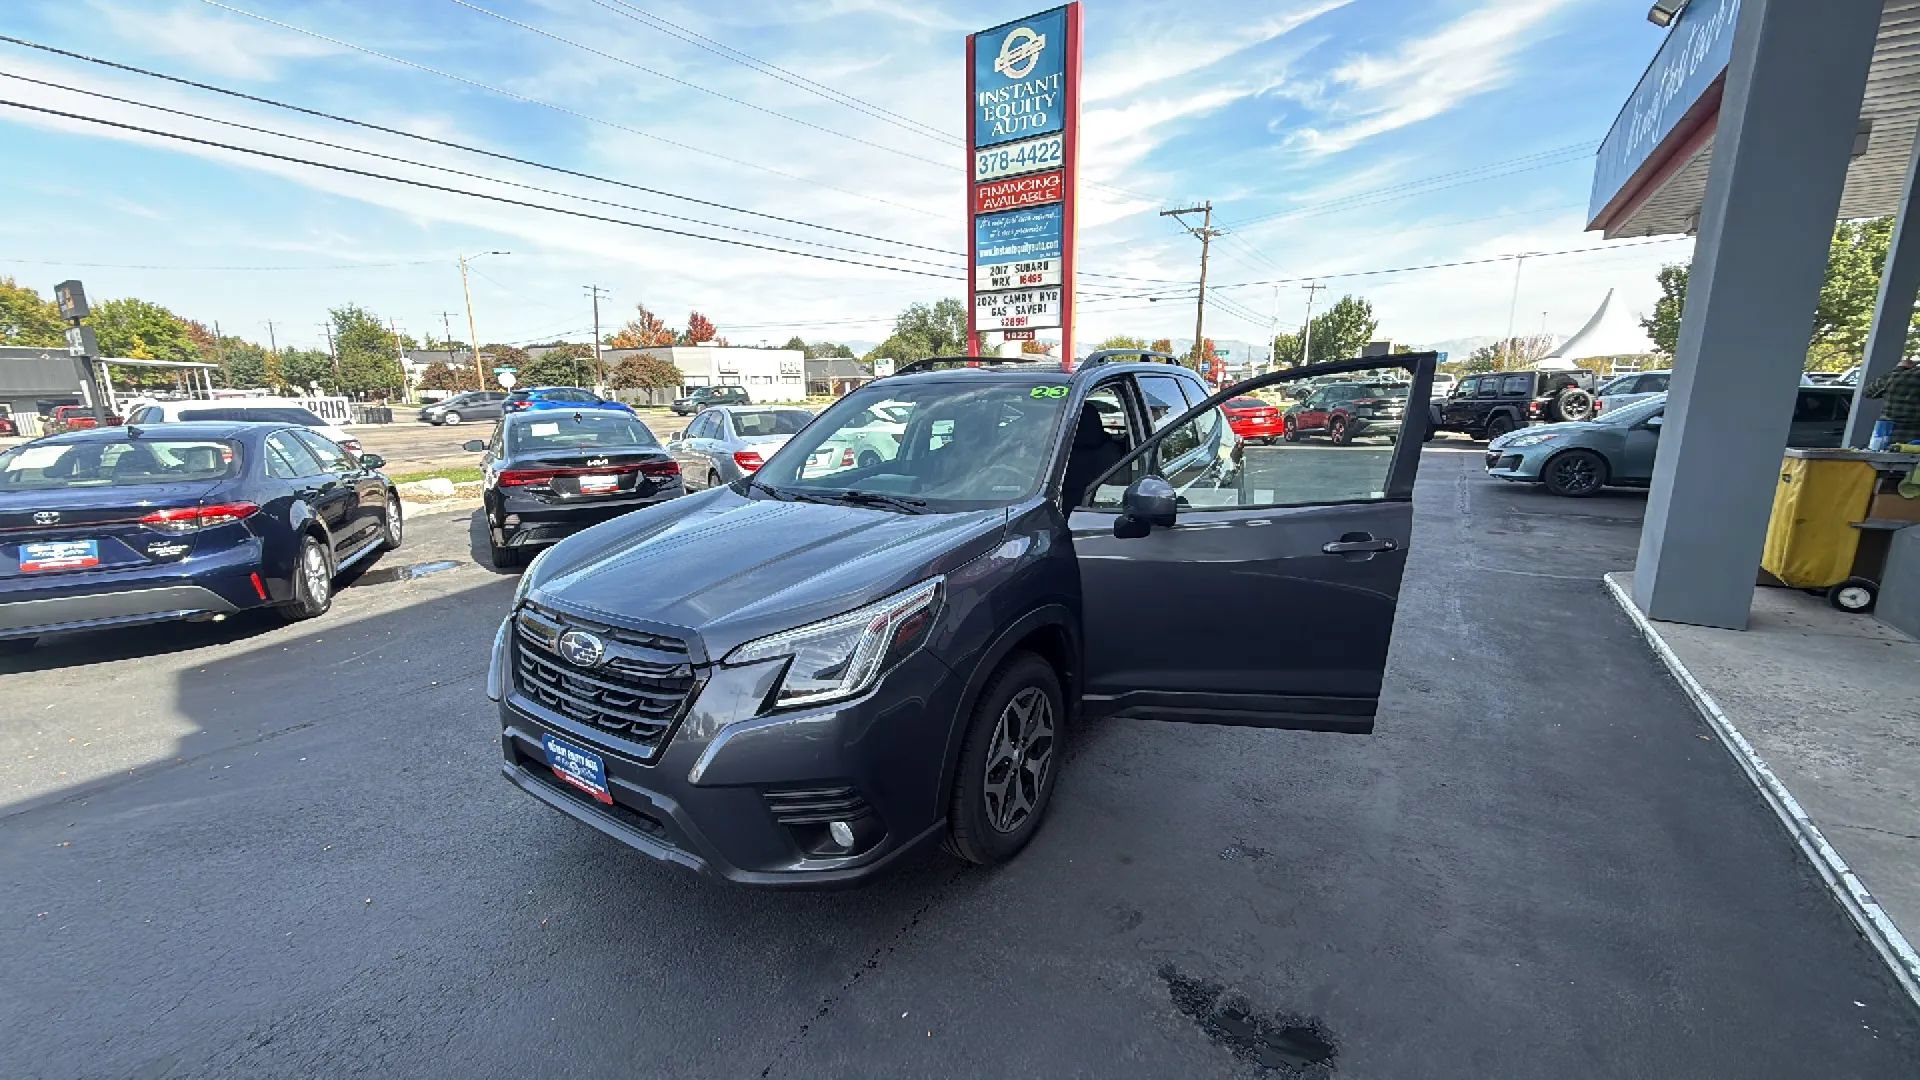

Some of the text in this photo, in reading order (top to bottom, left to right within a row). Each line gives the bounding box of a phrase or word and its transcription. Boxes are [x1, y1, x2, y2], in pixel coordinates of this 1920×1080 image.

[980, 72, 1062, 106] INSTANT
[984, 92, 1056, 121] EQUITY
[992, 112, 1046, 136] AUTO
[979, 140, 1060, 174] 378-4422
[980, 176, 1060, 198] FINANCING
[984, 188, 1056, 208] AVAILABLE
[990, 261, 1048, 276] 2017 SUBARU
[992, 276, 1010, 286] WRX
[977, 296, 997, 306] 2024
[1003, 293, 1032, 304] CAMRY
[992, 307, 1006, 316] GAS
